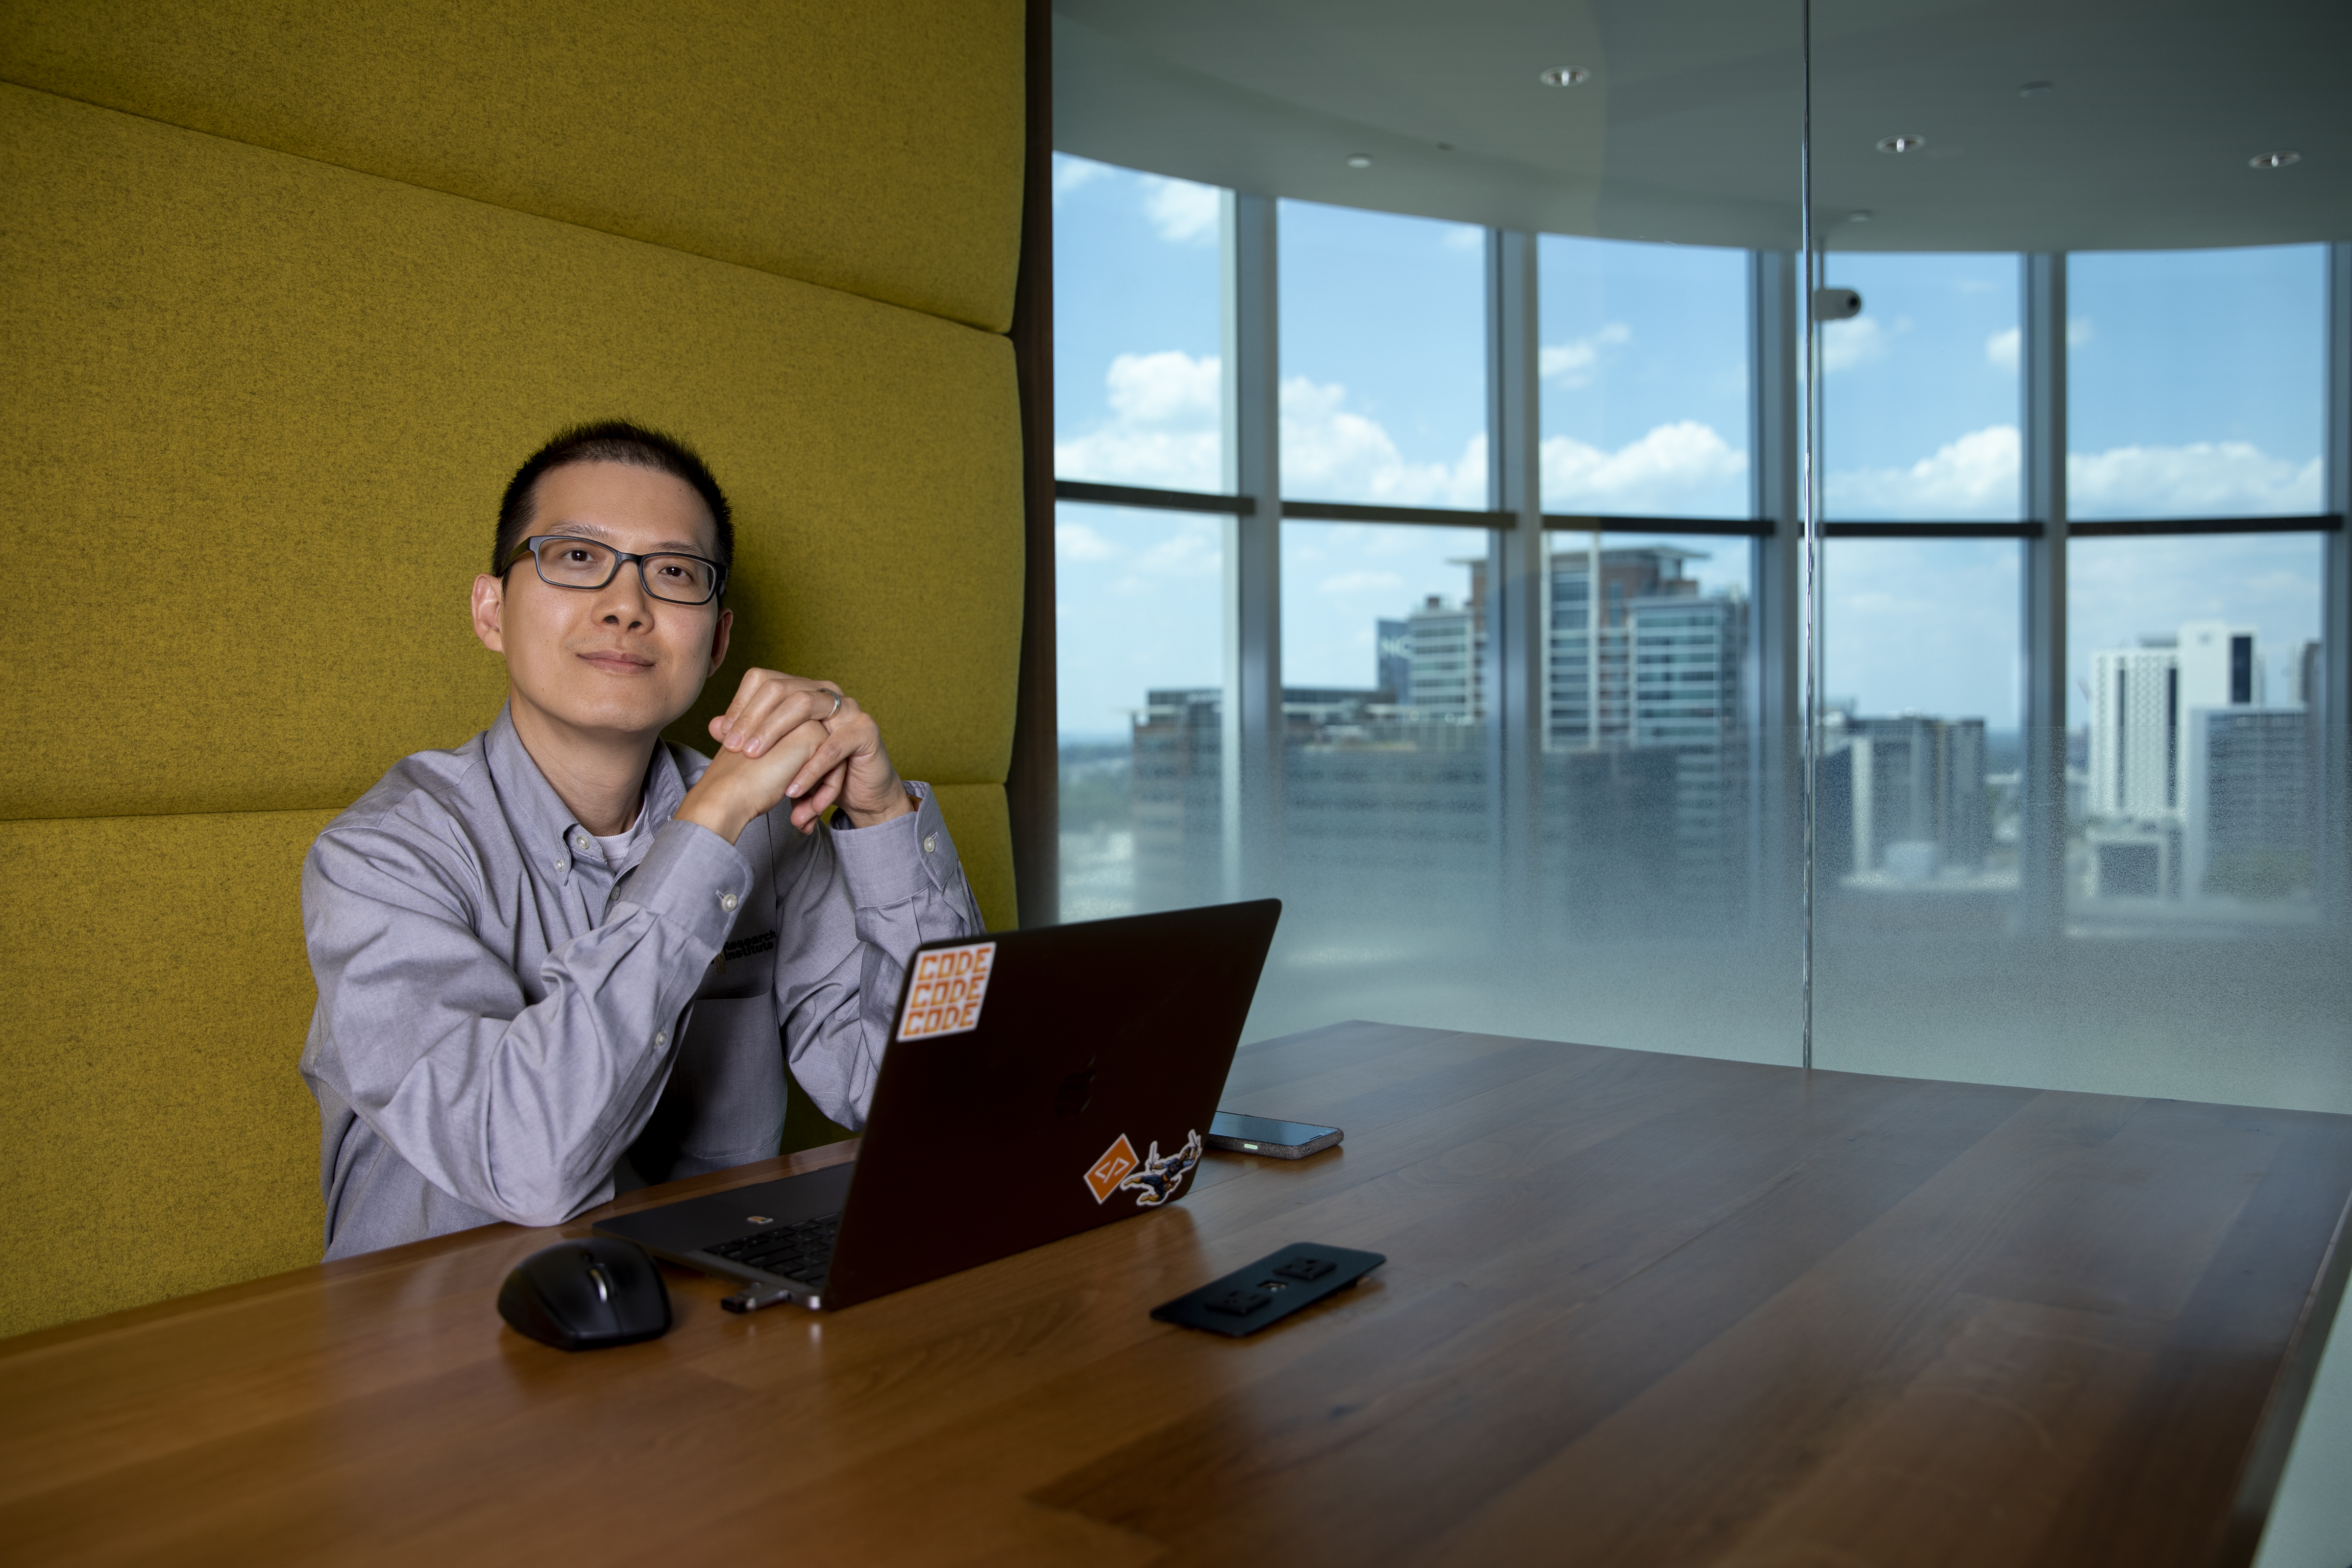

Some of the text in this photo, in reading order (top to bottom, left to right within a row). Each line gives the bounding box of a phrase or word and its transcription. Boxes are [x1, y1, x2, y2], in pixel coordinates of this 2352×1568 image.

[723, 930, 776, 951] Research
[723, 941, 774, 961] Institute
[917, 947, 992, 981] CODE
[910, 974, 986, 1009] CODE
[903, 1001, 979, 1037] CODE
